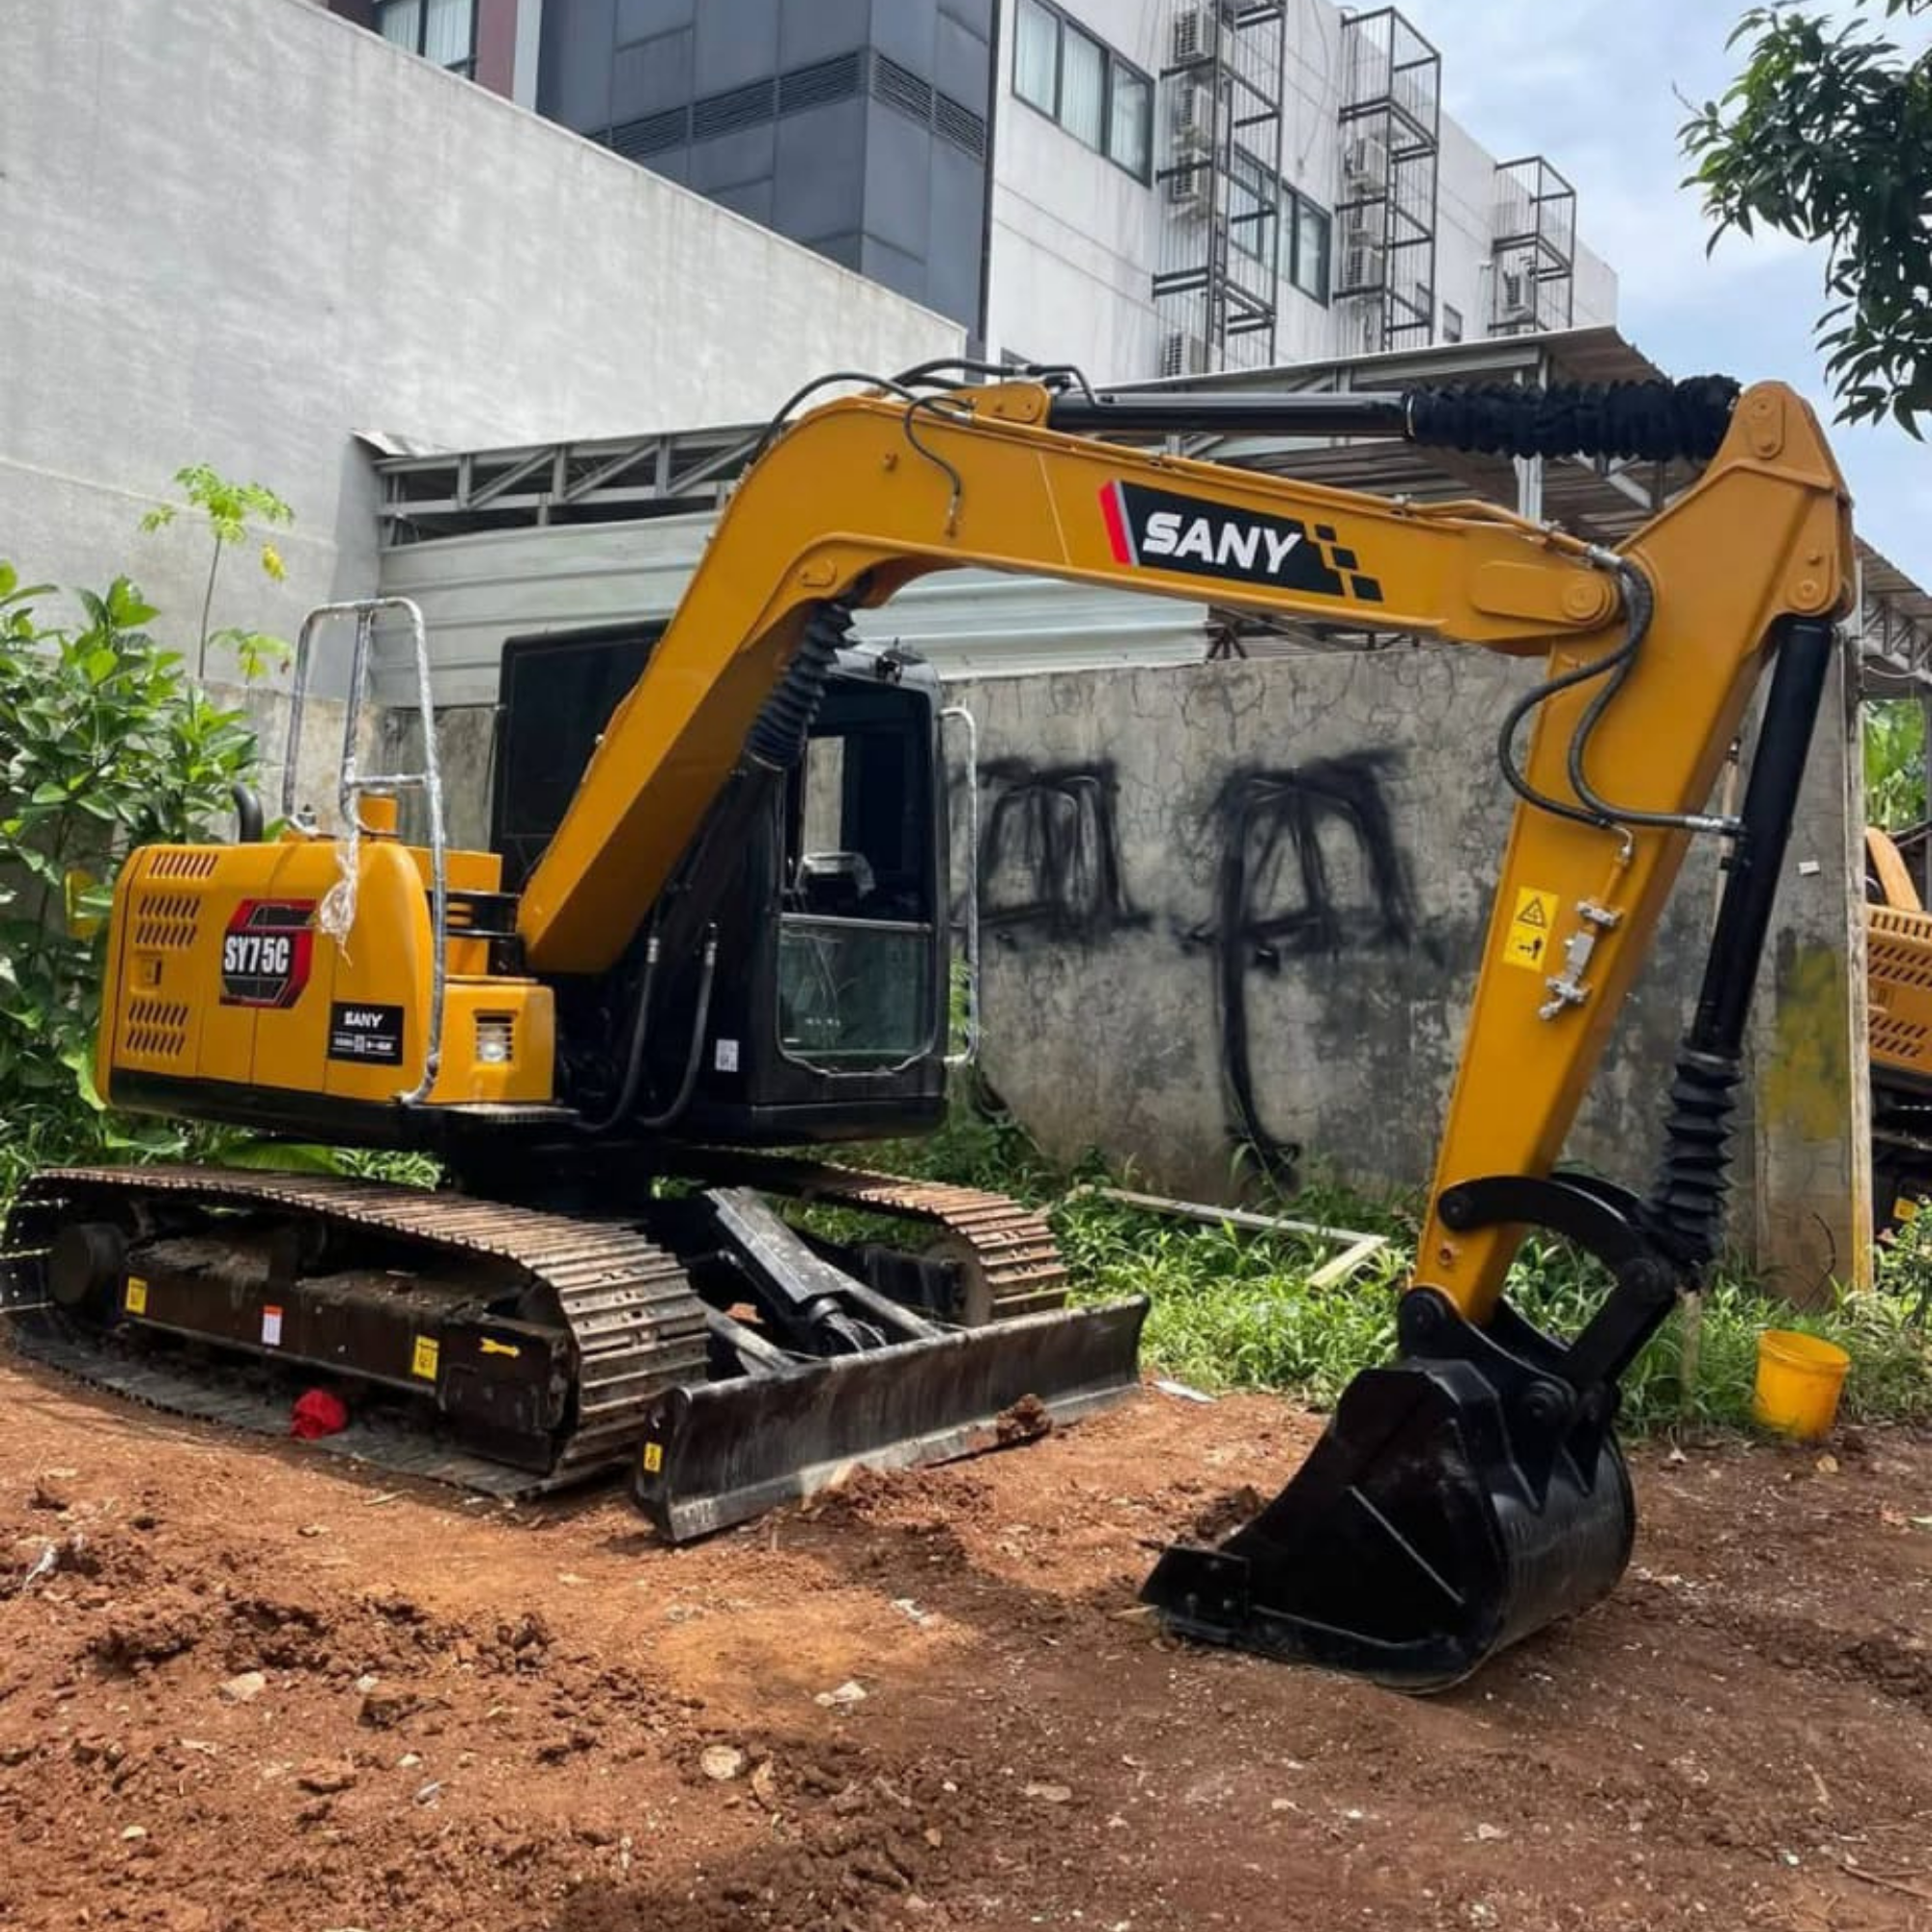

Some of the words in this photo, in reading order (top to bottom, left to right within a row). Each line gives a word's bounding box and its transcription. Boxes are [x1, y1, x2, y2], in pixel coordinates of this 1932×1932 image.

[1143, 512, 1301, 573] SANY
[224, 936, 290, 974] SY75C
[344, 1010, 384, 1028] SANY
